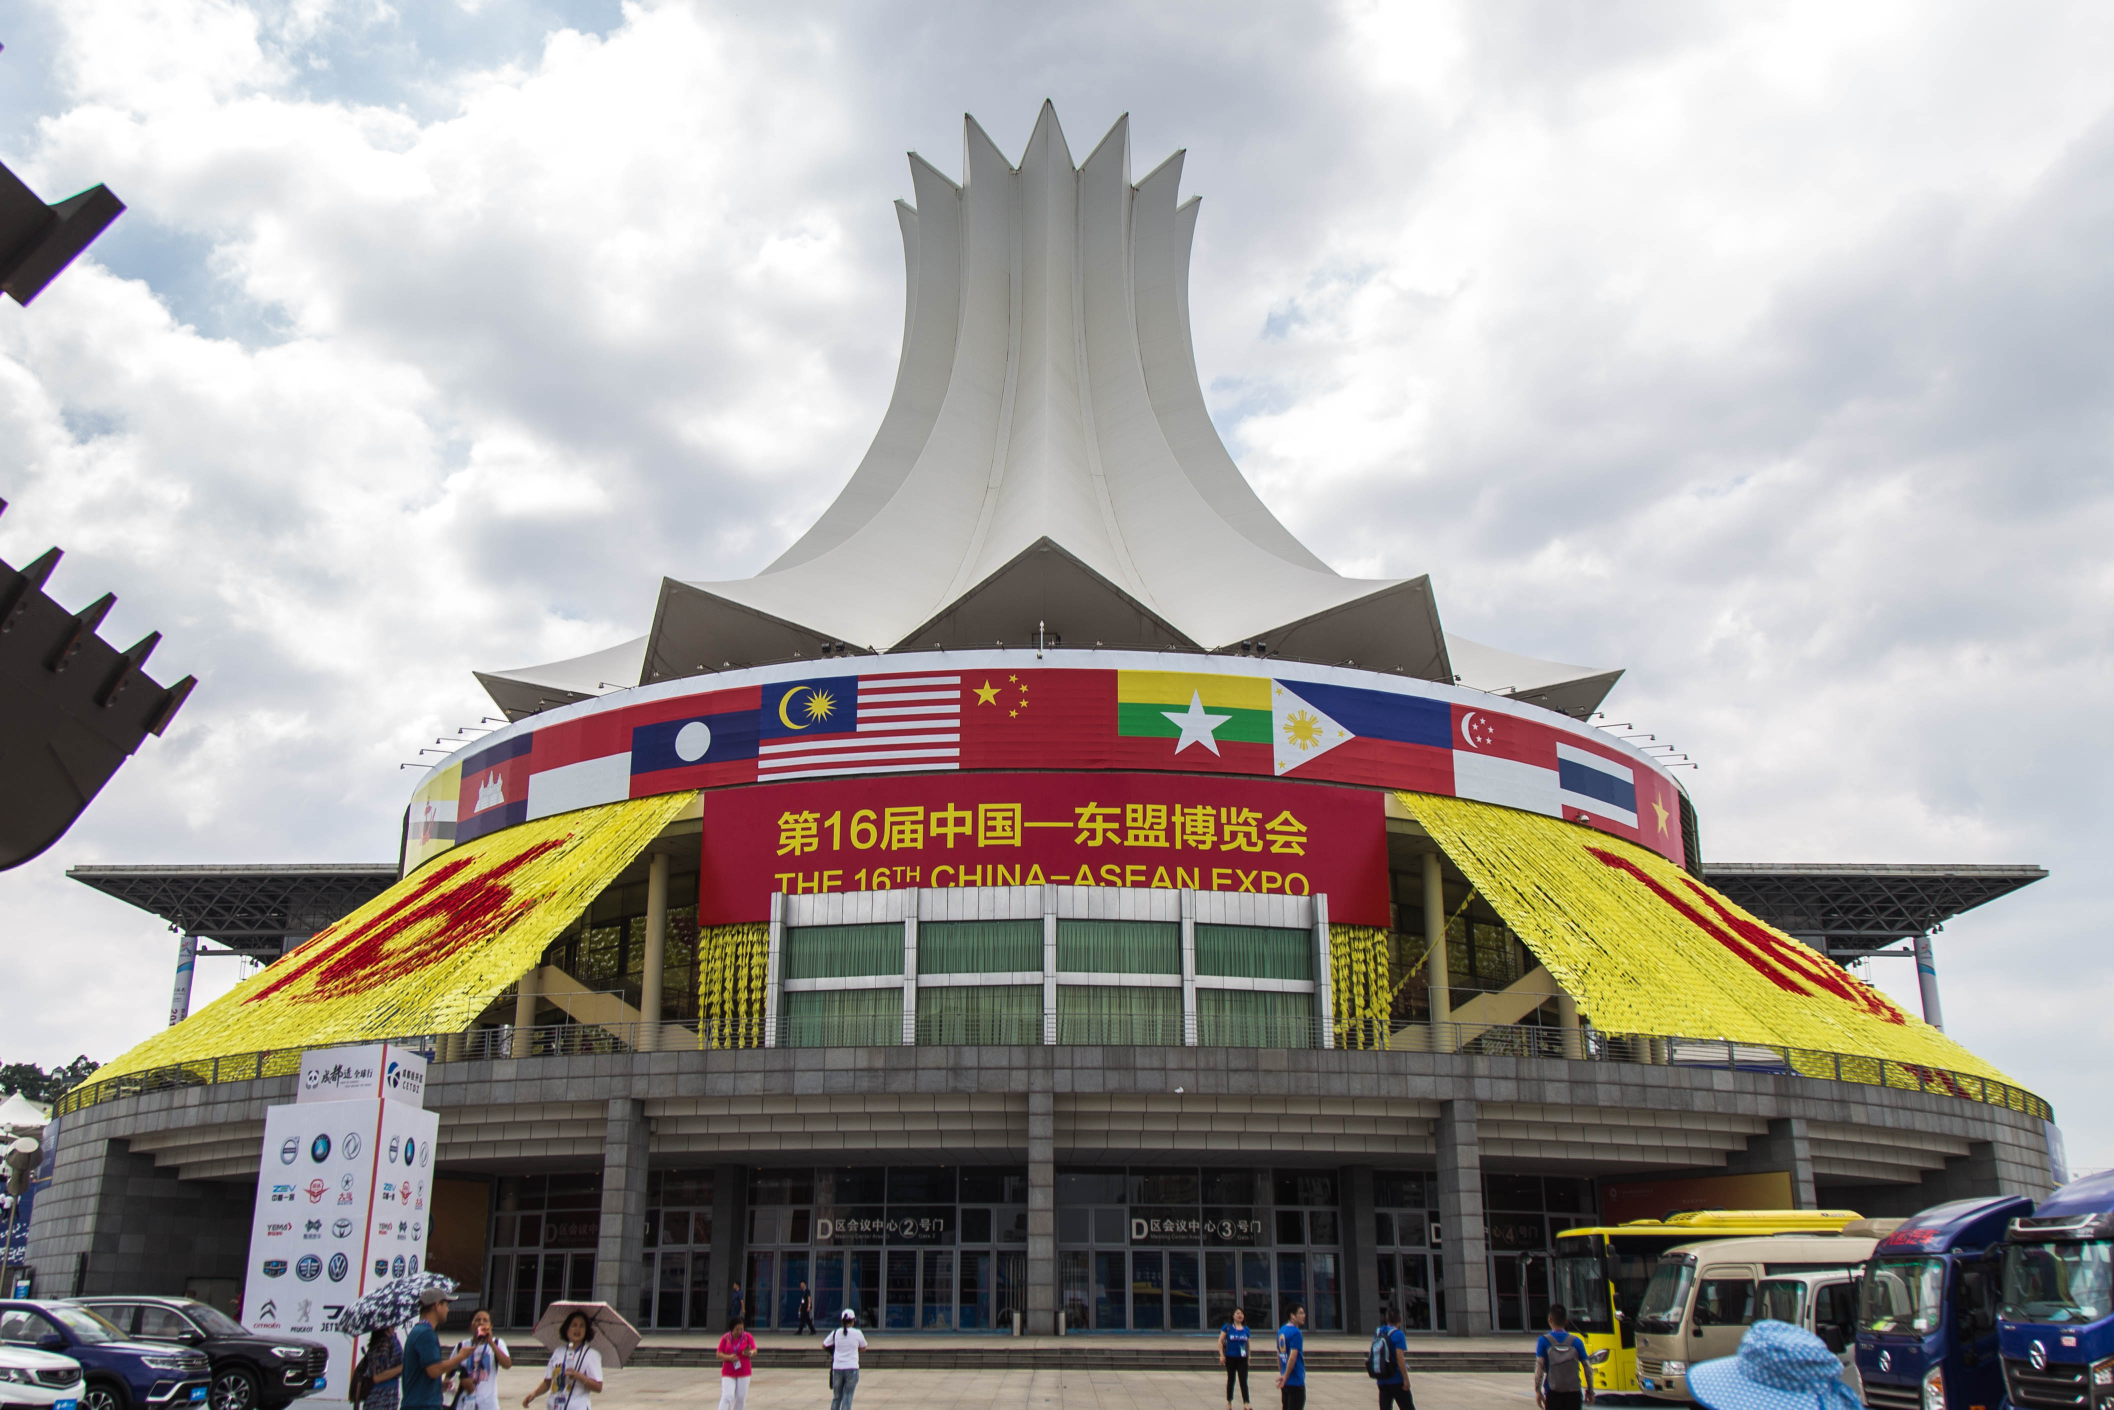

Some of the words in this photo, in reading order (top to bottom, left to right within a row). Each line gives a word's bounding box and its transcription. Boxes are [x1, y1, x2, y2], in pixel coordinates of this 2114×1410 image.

[1212, 868, 1310, 896] EXPO
[402, 1081, 420, 1093] CETDZ
[273, 1184, 297, 1192] ZEV
[267, 1223, 289, 1231] YEMA
[320, 1322, 343, 1332] JETT
